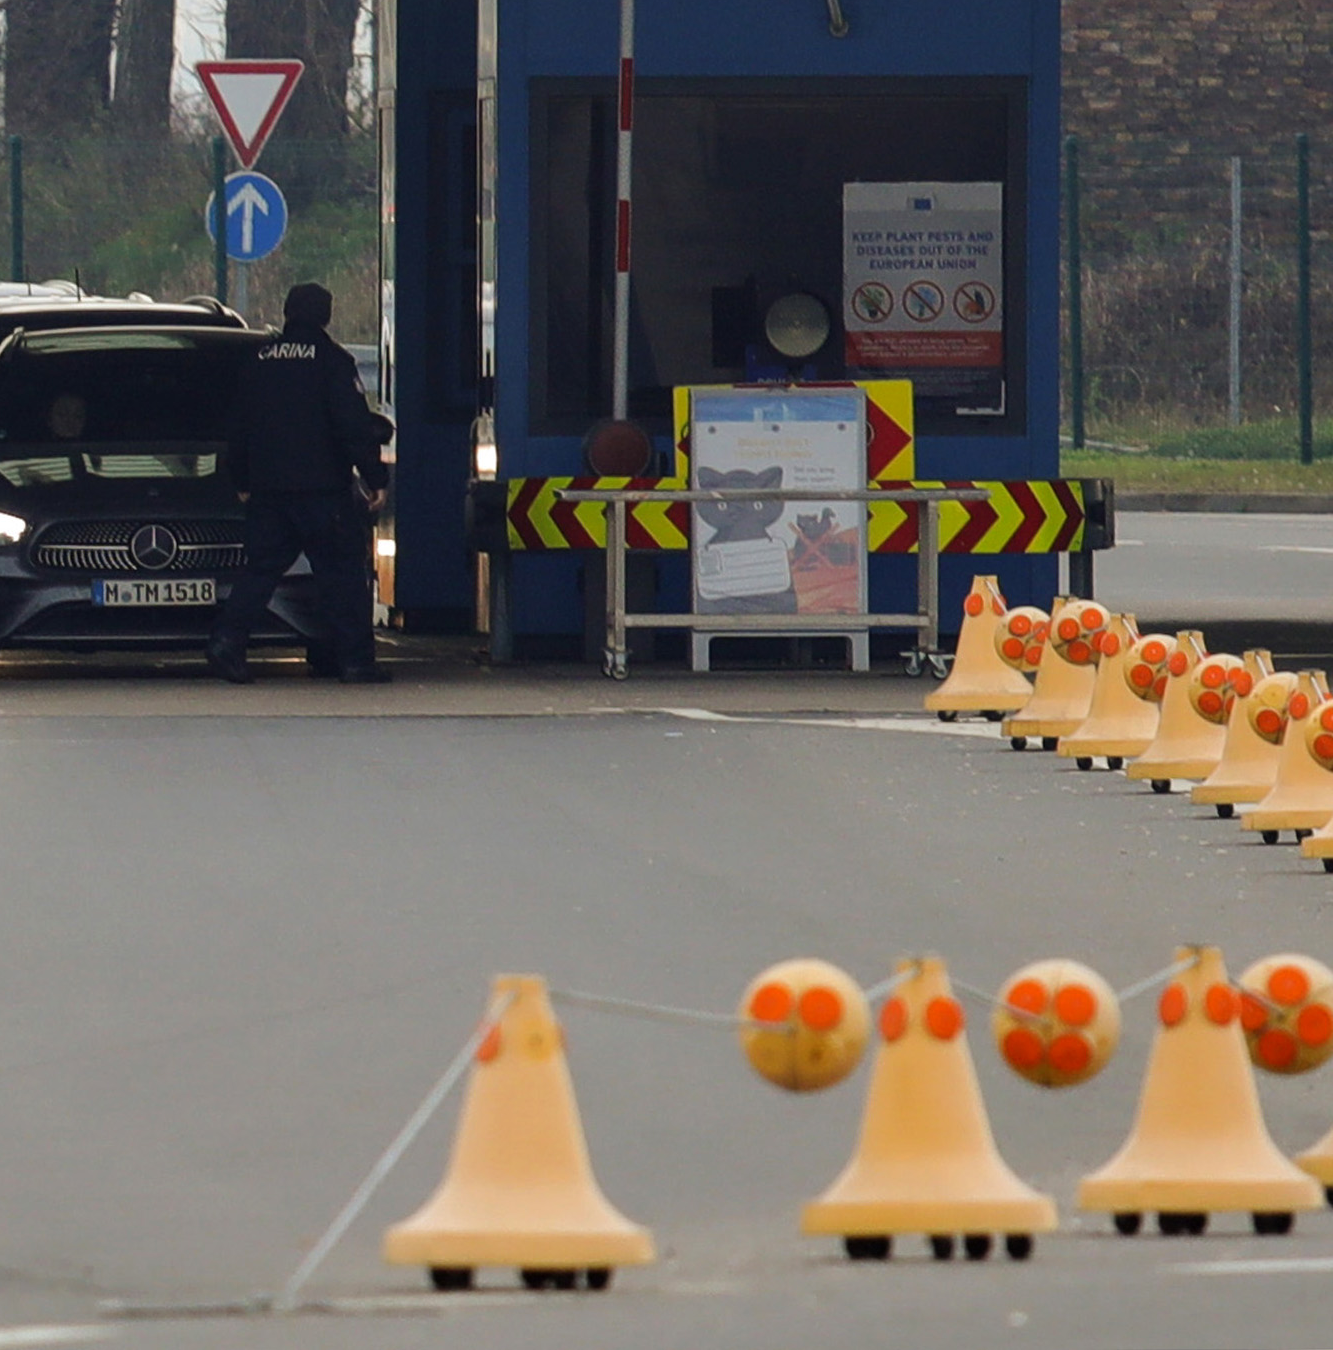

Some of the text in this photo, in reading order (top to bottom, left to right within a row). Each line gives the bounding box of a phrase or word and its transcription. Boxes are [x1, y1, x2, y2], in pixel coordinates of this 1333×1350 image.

[852, 231, 994, 242] KEEP PLANT PESTS AND
[856, 244, 989, 256] DISEASES OUT OF THE
[869, 258, 977, 270] EUROPEAN UNION
[105, 582, 213, 603] M TM 1518
